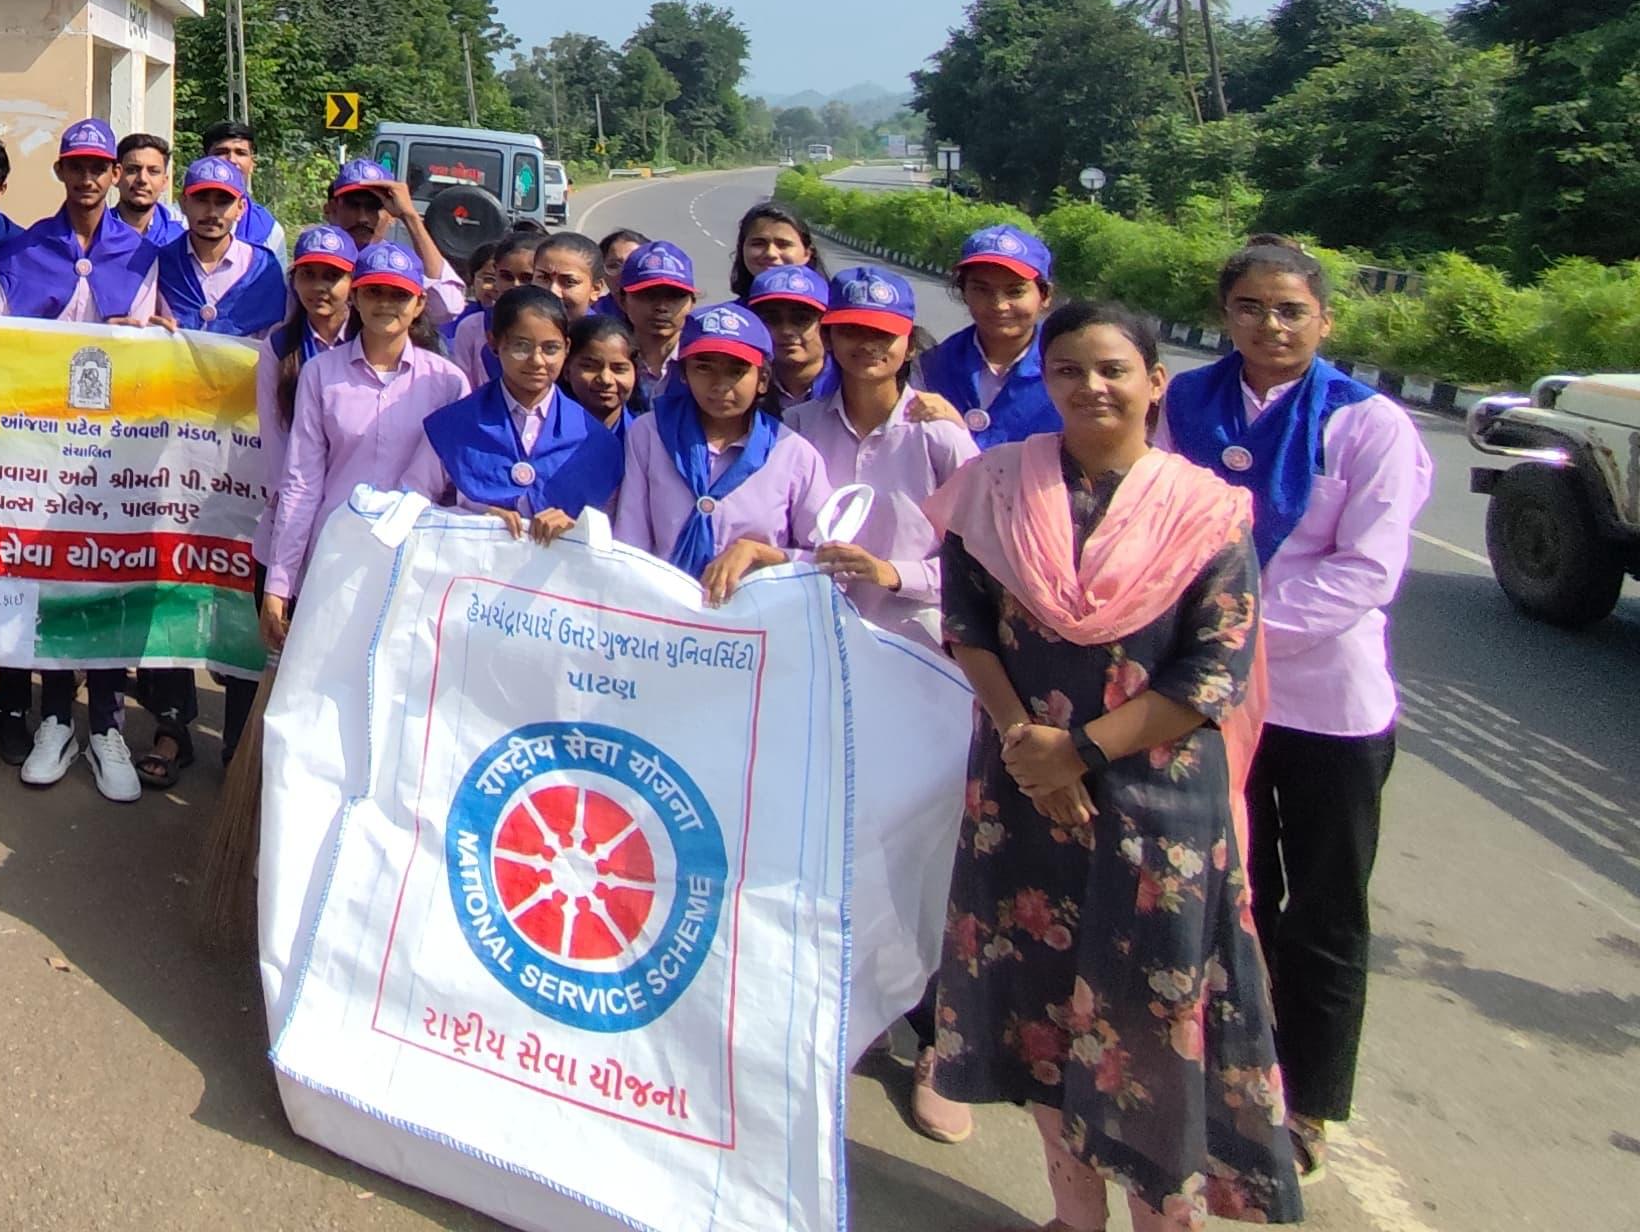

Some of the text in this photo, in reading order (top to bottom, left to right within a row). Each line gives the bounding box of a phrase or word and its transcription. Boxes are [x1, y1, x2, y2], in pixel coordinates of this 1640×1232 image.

[1, 414, 58, 434] આંજણા
[66, 418, 101, 436] પટેલ
[110, 420, 169, 439] કેળવણી
[177, 423, 222, 446] મંડળ,
[63, 443, 112, 459] સંચાલિત
[59, 465, 97, 488] અને
[109, 467, 170, 490] શ્રીમતી
[44, 493, 108, 520] કોલેજ,
[121, 501, 200, 524] પાલનપુર
[66, 537, 156, 570] યોજના
[558, 616, 595, 651] ઉત્તર
[598, 628, 660, 661] ગુજરાત
[567, 670, 637, 700] પાટણ
[475, 727, 704, 832] राष्ट्रीय सेवा योजना
[457, 829, 712, 1016] NATIONAL SERVICE SCHEME
[422, 1007, 689, 1119] રાષ્ટ્રીય સેવા યોજના
